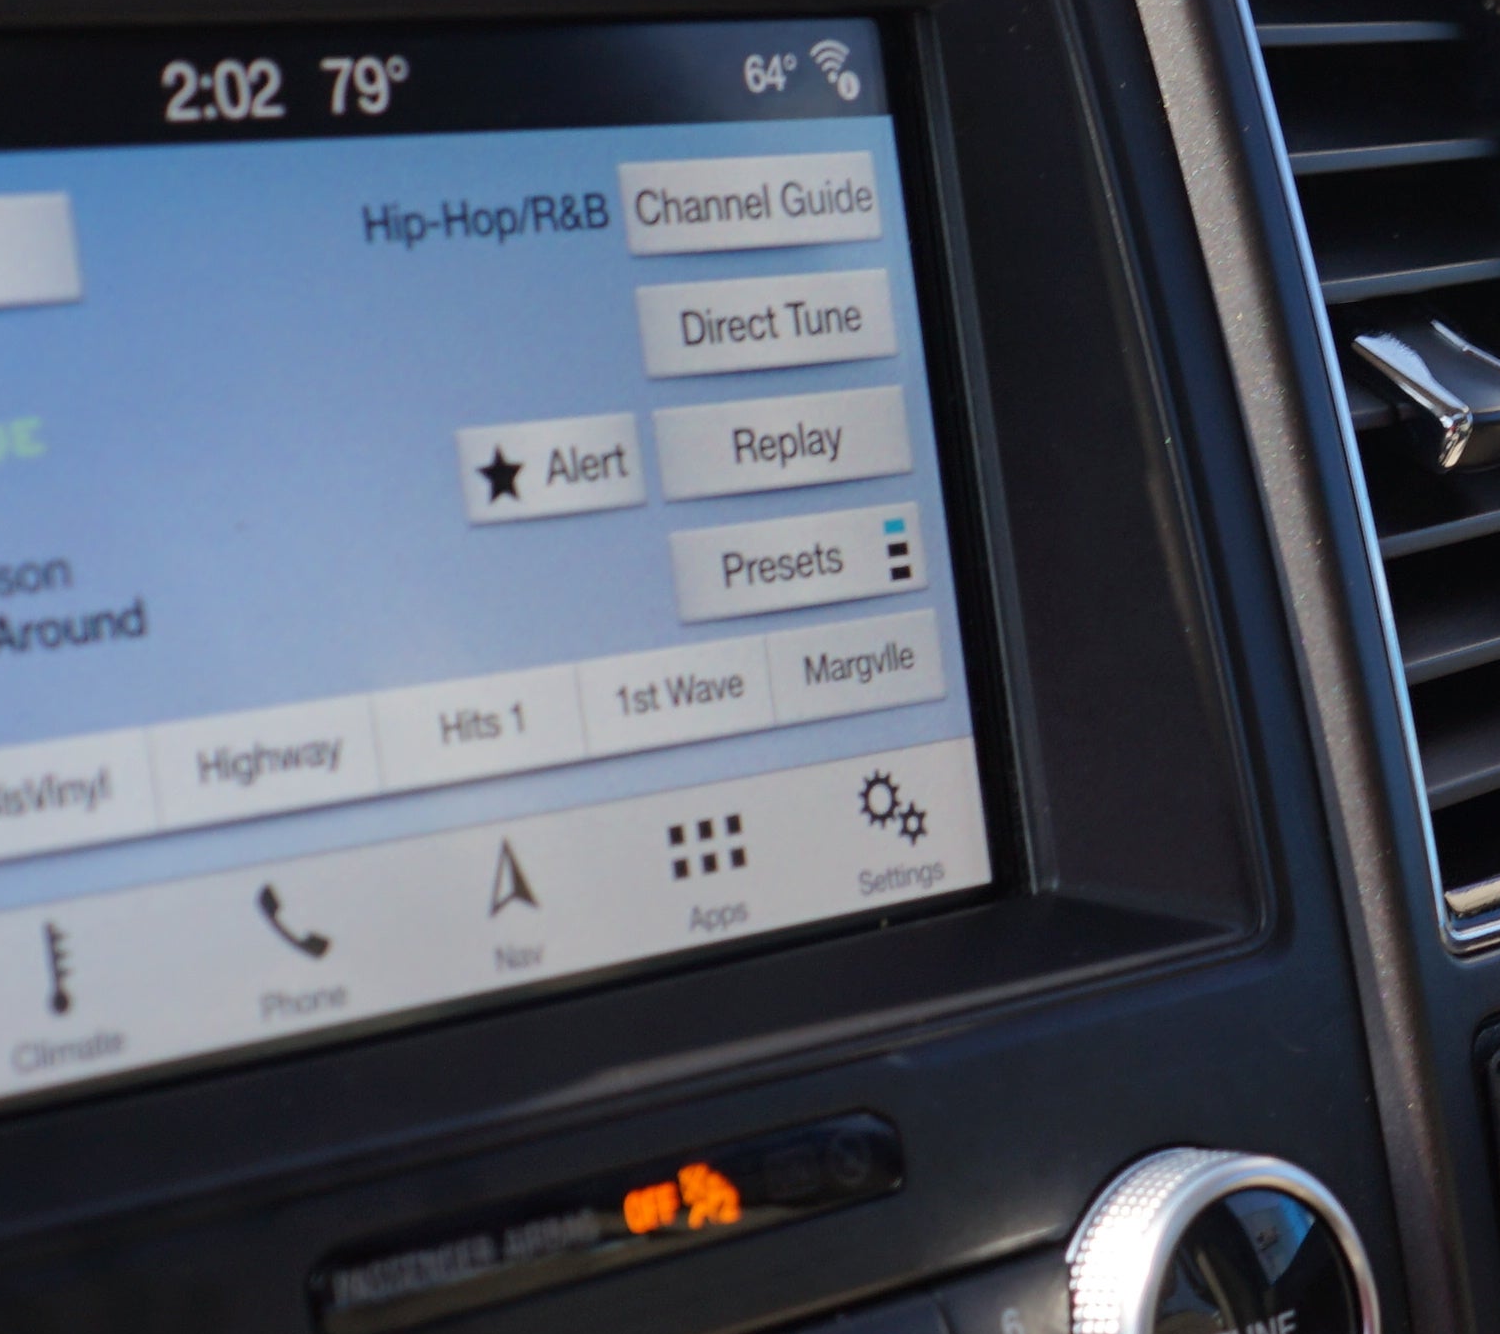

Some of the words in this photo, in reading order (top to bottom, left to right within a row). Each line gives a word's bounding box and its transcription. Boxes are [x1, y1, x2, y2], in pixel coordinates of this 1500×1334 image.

[161, 59, 286, 122] 2:02
[320, 56, 409, 116] 79°
[743, 54, 798, 94] 64°
[362, 192, 610, 249] Hip-Hop/R&B
[634, 185, 771, 227] Channel
[781, 180, 874, 217] Guide
[680, 310, 779, 347] Direct
[784, 301, 862, 337] Tune
[546, 443, 628, 486] Alert
[732, 423, 843, 467] Replay
[721, 542, 844, 588] Presets
[615, 683, 661, 717] 1st
[665, 671, 745, 708] Wave
[438, 710, 501, 745] Hits
[509, 701, 527, 734] 1
[196, 737, 344, 787] Highway
[857, 860, 947, 897] Settings
[688, 900, 749, 935] Apps
[494, 943, 544, 973] Nav
[258, 984, 348, 1021] Phone
